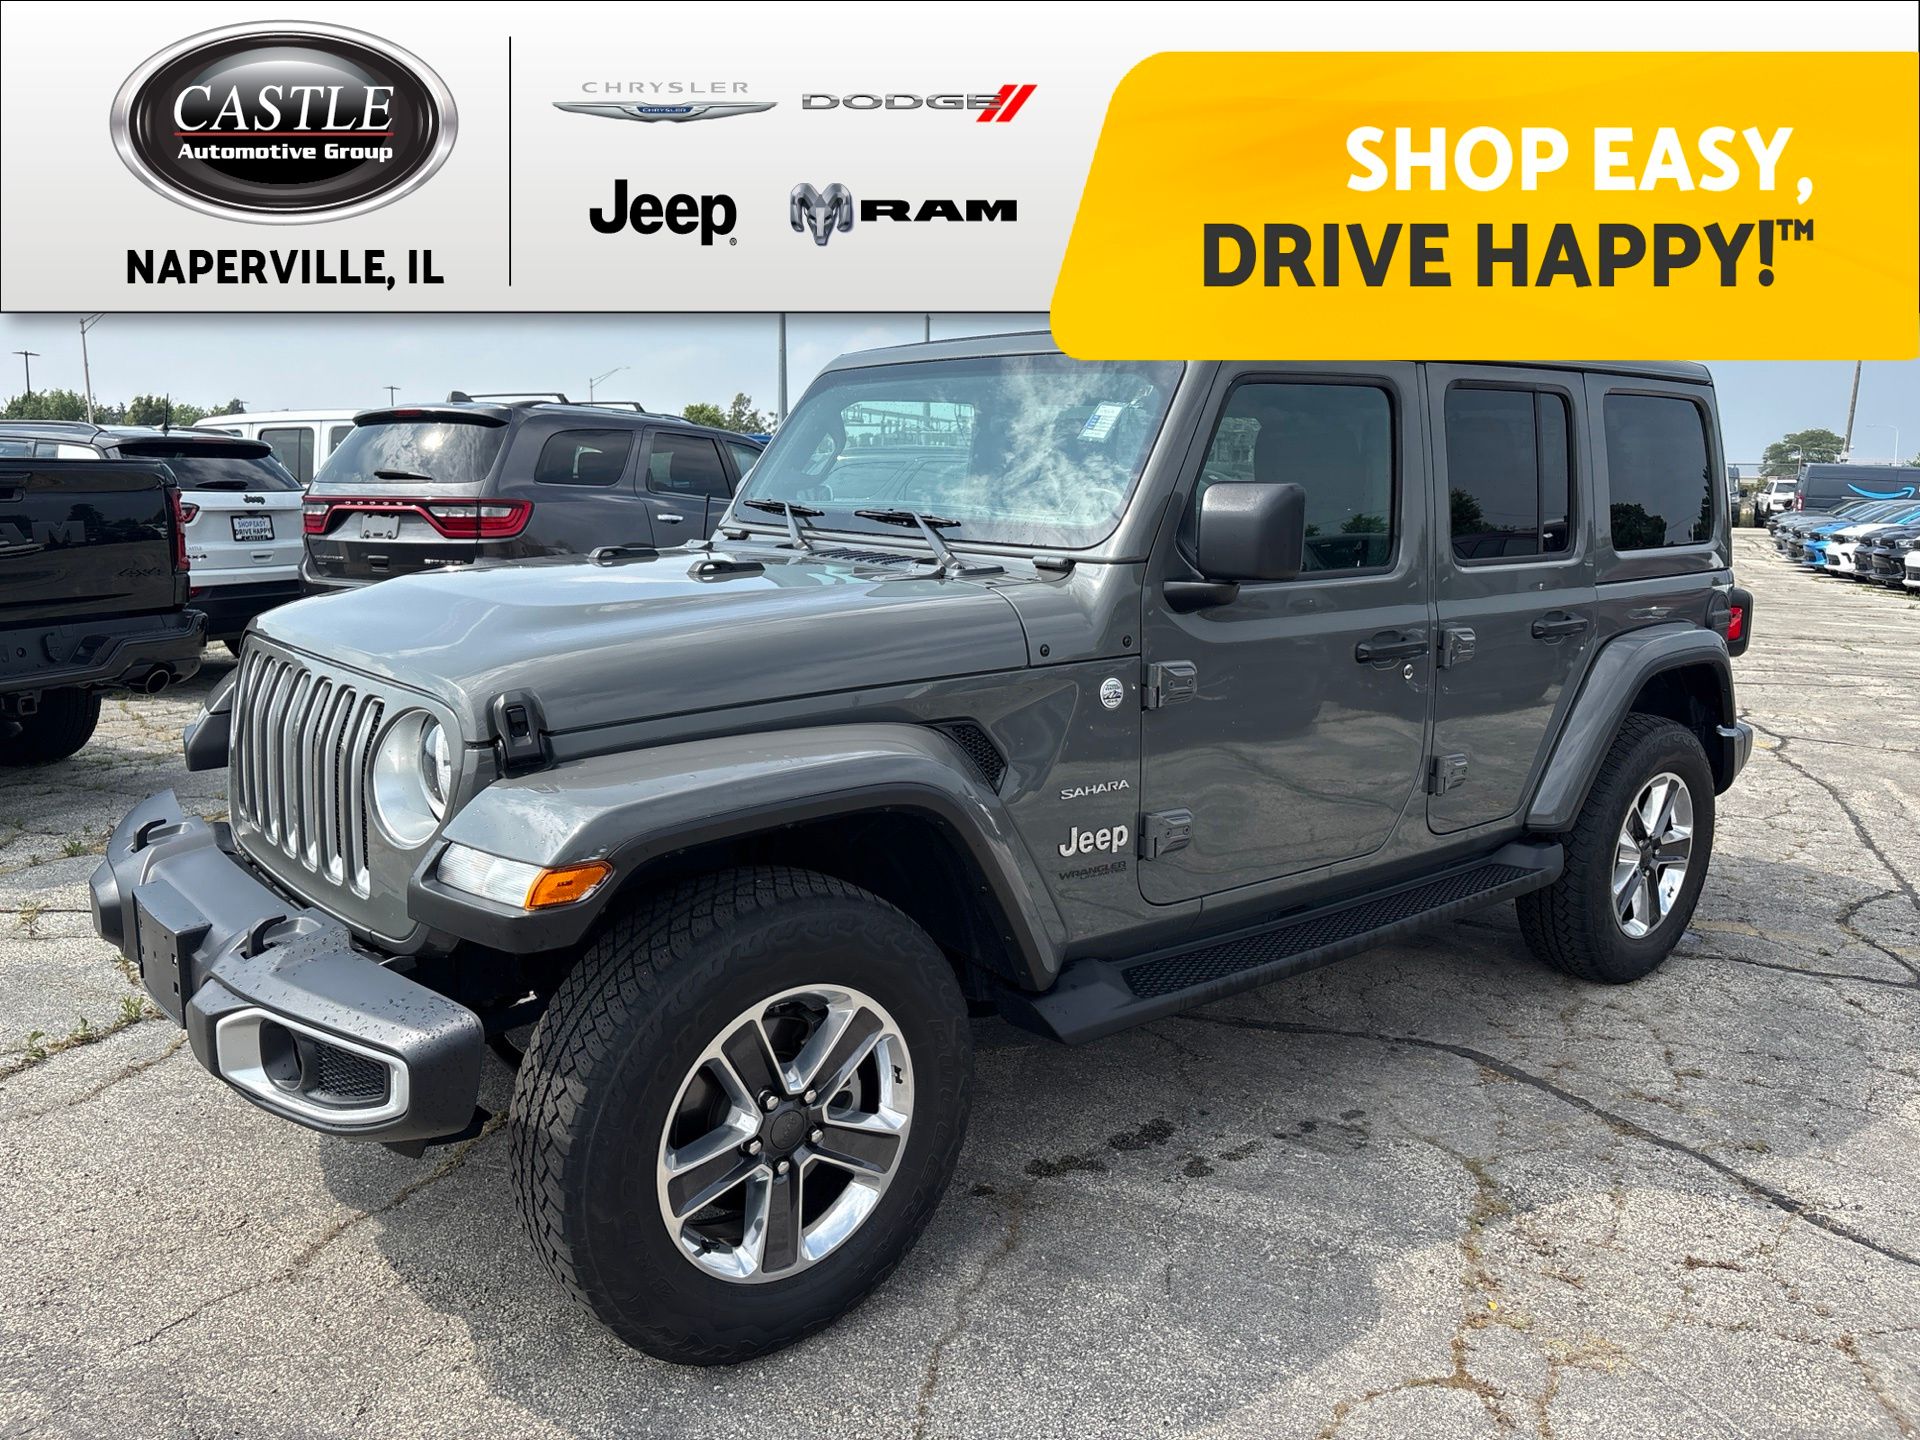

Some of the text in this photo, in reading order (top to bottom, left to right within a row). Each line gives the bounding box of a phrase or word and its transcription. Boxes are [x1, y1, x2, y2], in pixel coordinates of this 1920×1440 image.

[1060, 779, 1130, 800] SAHARA
[1059, 824, 1129, 857] Jeep
[1058, 860, 1127, 880] WRANGLER
